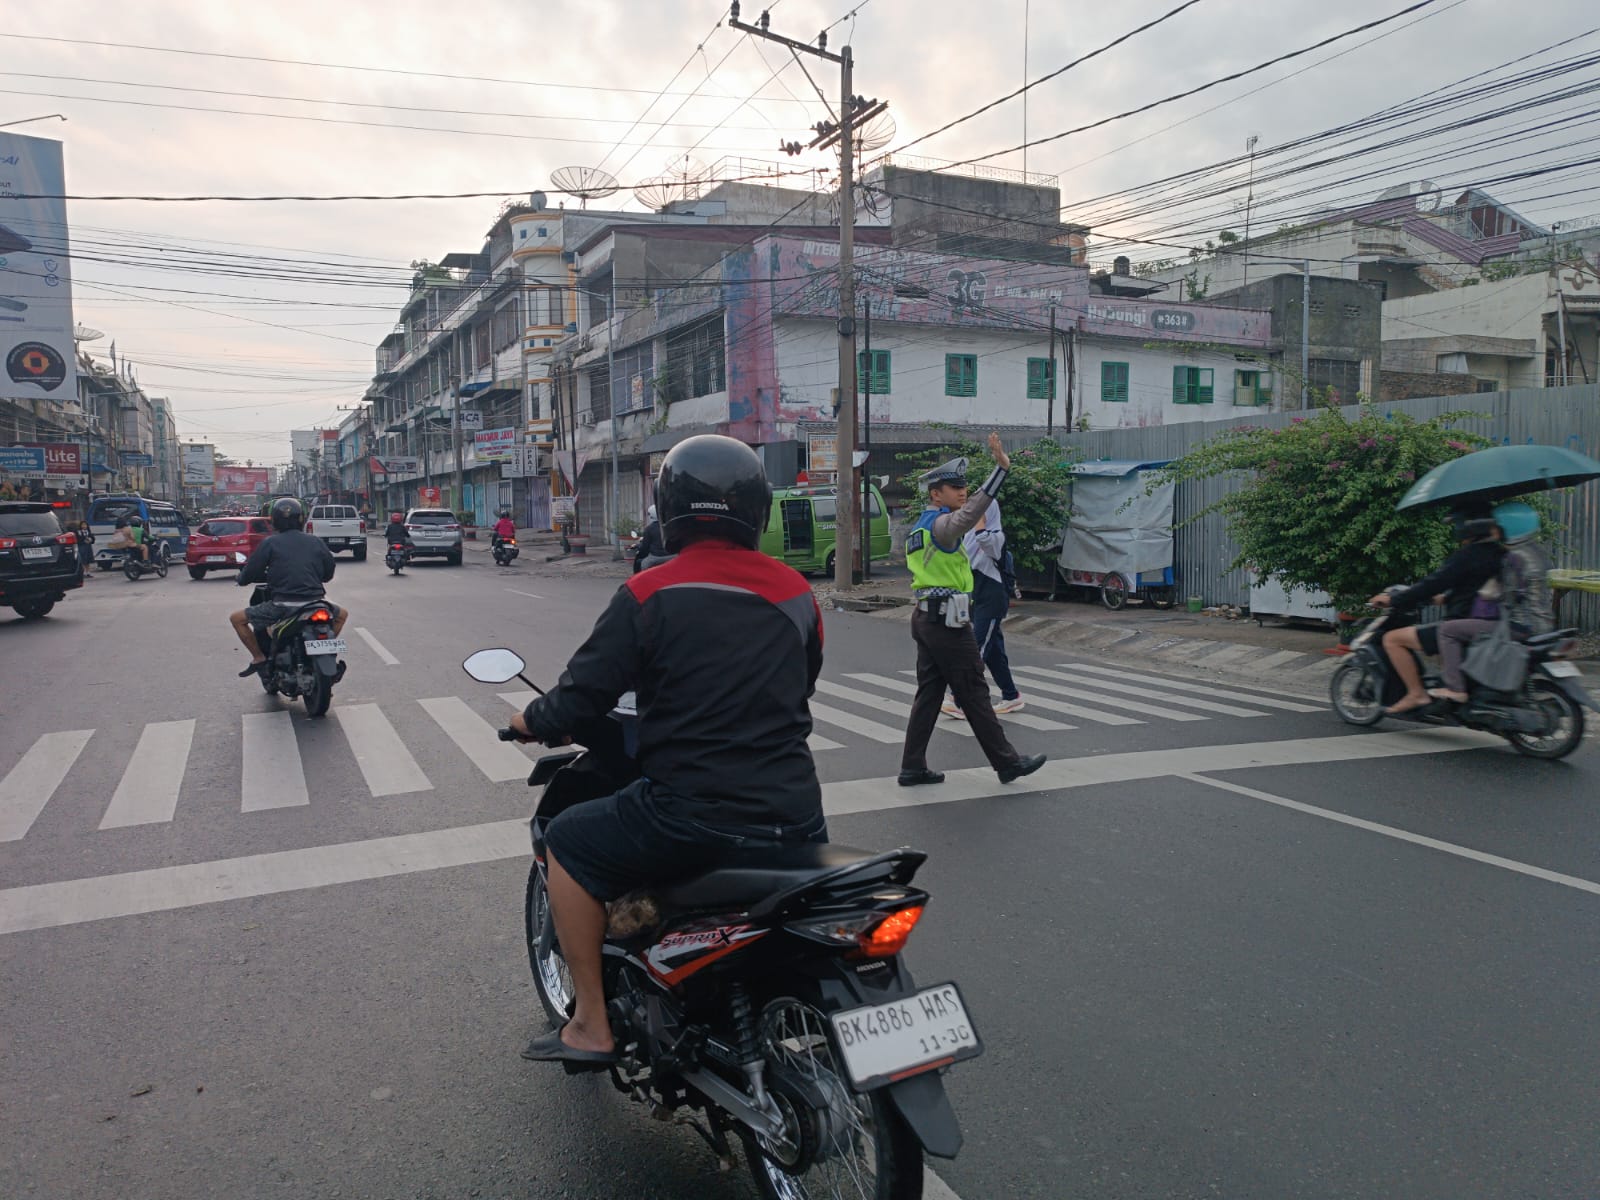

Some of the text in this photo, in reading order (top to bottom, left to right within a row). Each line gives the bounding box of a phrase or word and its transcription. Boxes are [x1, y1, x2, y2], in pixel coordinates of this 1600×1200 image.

[946, 268, 988, 309] 3G
[691, 503, 729, 511] HONDA
[856, 961, 886, 972] HONDA
[918, 990, 959, 1020] WAS
